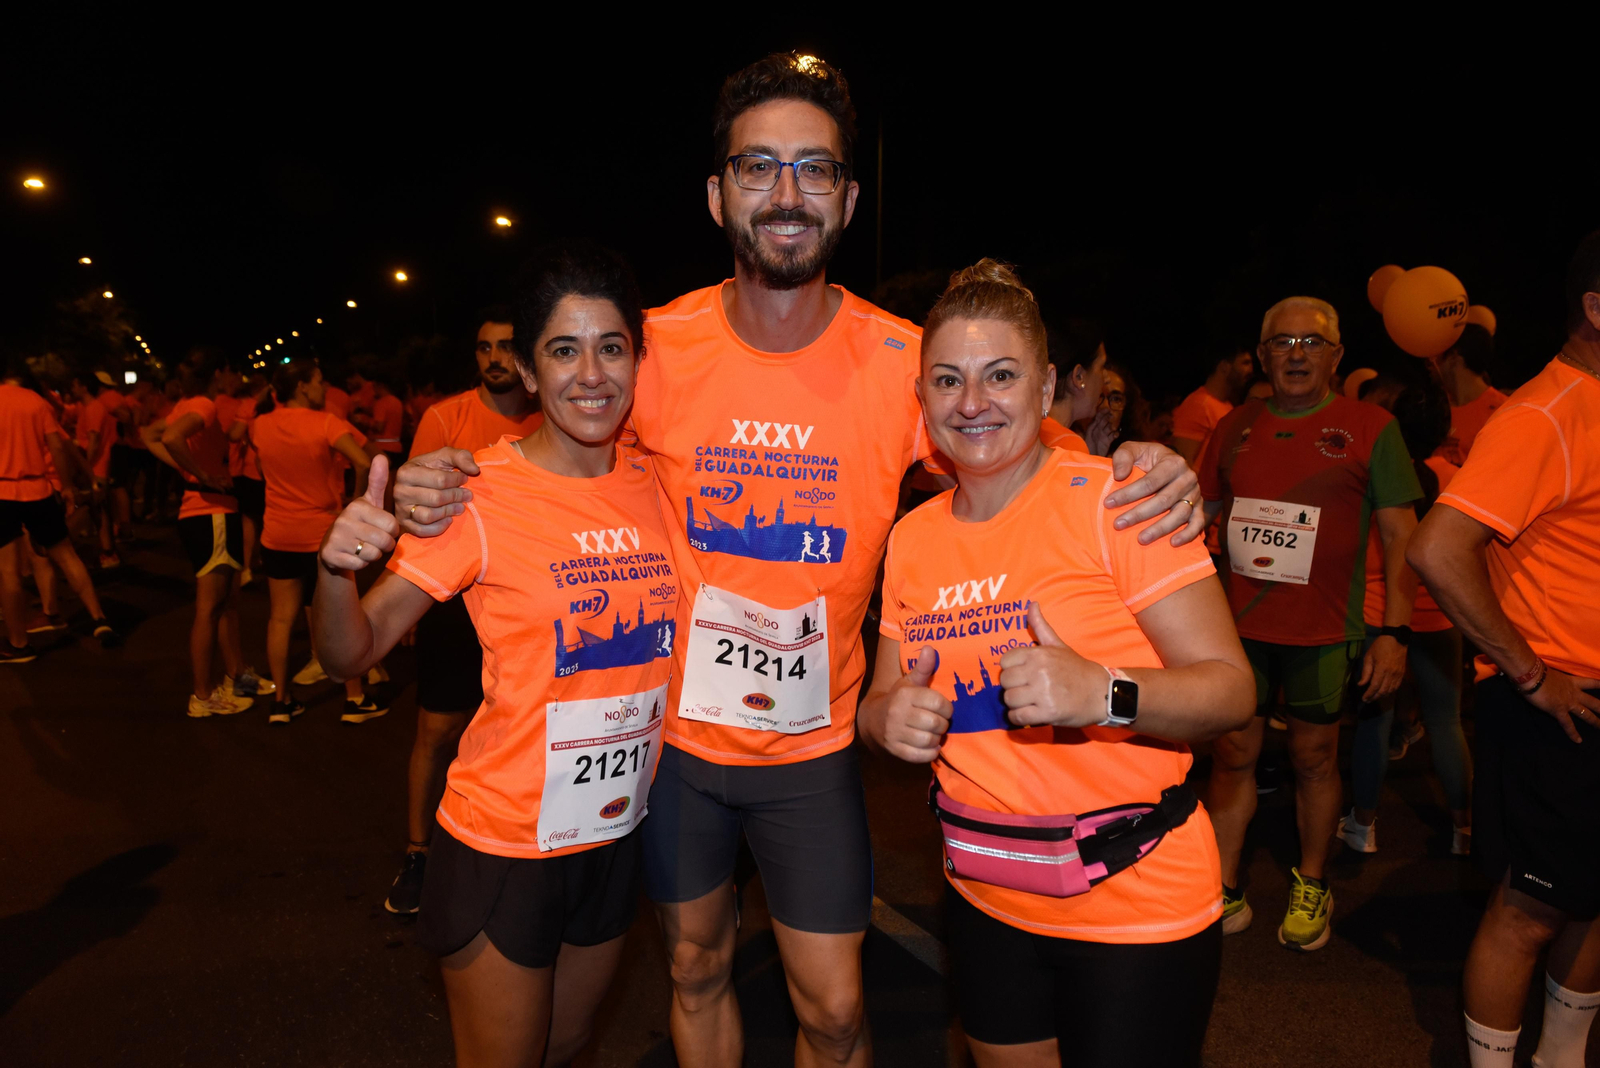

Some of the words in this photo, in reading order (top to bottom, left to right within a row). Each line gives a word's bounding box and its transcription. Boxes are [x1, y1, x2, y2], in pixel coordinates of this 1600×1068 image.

[729, 418, 814, 450] XXXV
[695, 446, 758, 461] CARRERA
[764, 452, 839, 467] NOCTURNA
[694, 457, 702, 472] DEL
[704, 459, 838, 482] GUADALQUIVIR
[571, 527, 640, 554] XXXV
[690, 538, 708, 551] 2023
[1241, 526, 1298, 549] 17562
[550, 556, 611, 573] CARRERA
[613, 552, 667, 566] NOCTURNA
[553, 573, 565, 589] DEL
[565, 564, 673, 586] GUADALQUIVIR
[932, 574, 1007, 611] XXXV
[905, 612, 953, 627] CARRERA
[698, 620, 713, 629] XXXV
[713, 623, 736, 633] CARRERA
[760, 637, 768, 646] DEL
[559, 662, 579, 677] 2023
[715, 638, 807, 682] 21214
[788, 713, 825, 728] Cruzcampo
[553, 742, 570, 750] XXXV
[570, 739, 594, 748] CARRERA
[620, 733, 628, 741] DEL
[573, 740, 651, 785] 21217
[1523, 872, 1553, 889] ARTENGO
